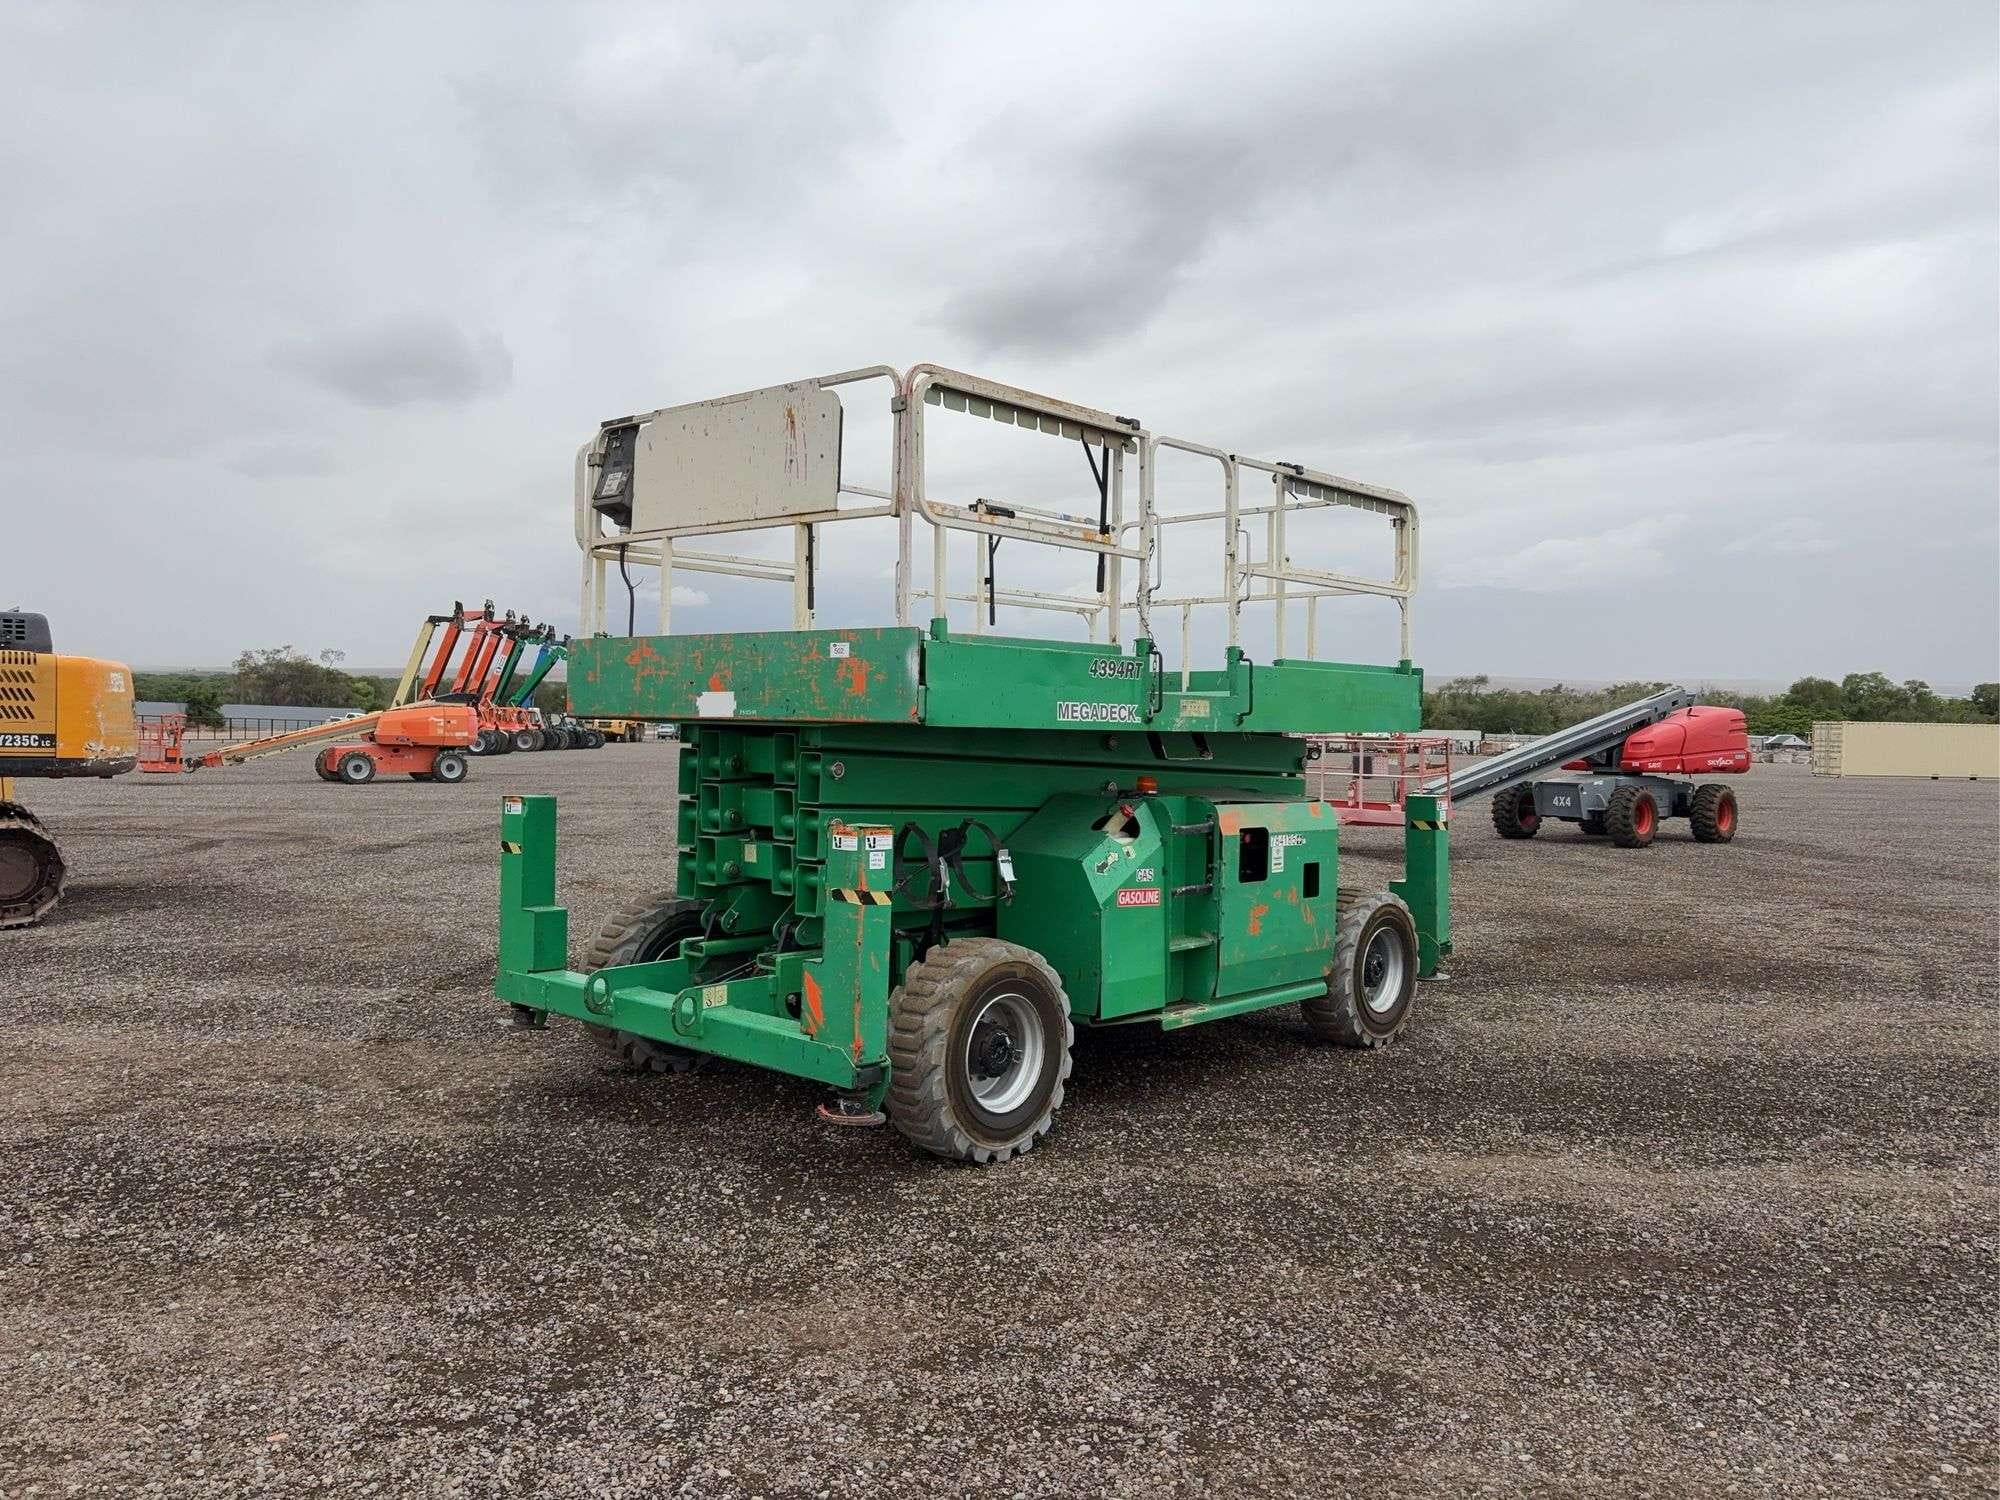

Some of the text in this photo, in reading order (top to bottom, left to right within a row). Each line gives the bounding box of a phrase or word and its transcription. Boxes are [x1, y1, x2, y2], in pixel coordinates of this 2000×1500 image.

[1089, 659, 1144, 680] 4394RT
[1057, 701, 1139, 723] MEGADECK
[1705, 757, 1735, 768] SKYJACK
[1552, 795, 1571, 807] 4X4
[1136, 868, 1154, 882] GAS
[1119, 890, 1159, 905] GASOLINE
